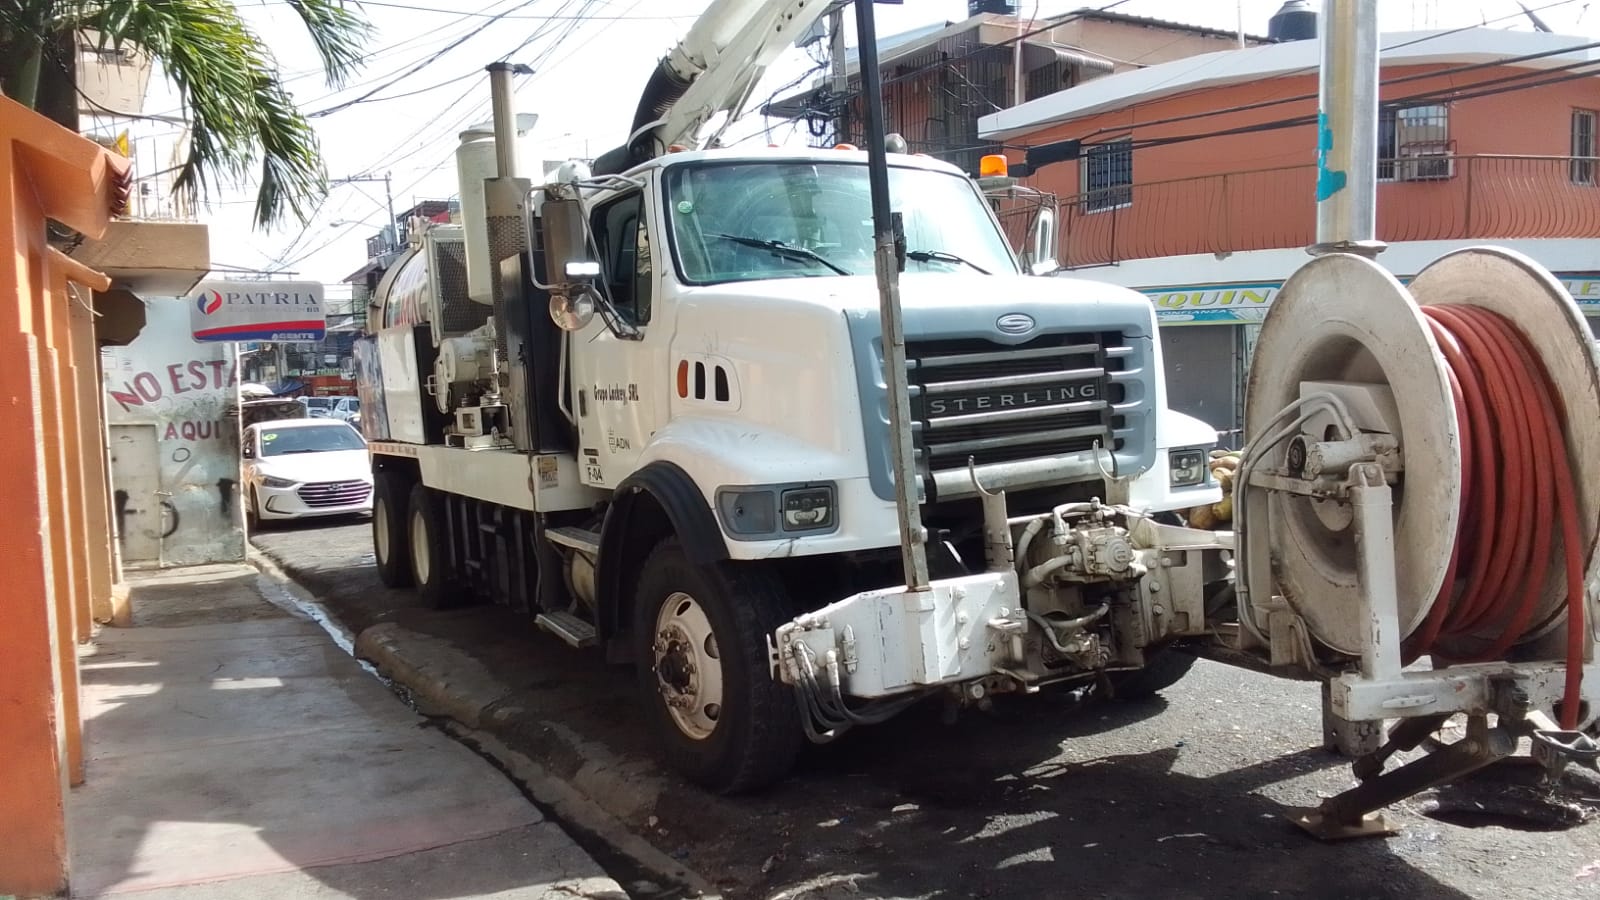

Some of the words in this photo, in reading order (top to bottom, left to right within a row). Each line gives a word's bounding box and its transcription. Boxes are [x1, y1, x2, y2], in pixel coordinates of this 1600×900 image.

[226, 291, 318, 305] PATRIA
[1149, 289, 1271, 308] QUIN
[110, 371, 163, 413] NO
[628, 383, 640, 401] SRL
[930, 383, 1097, 414] STERLING
[164, 420, 221, 441] AQUI
